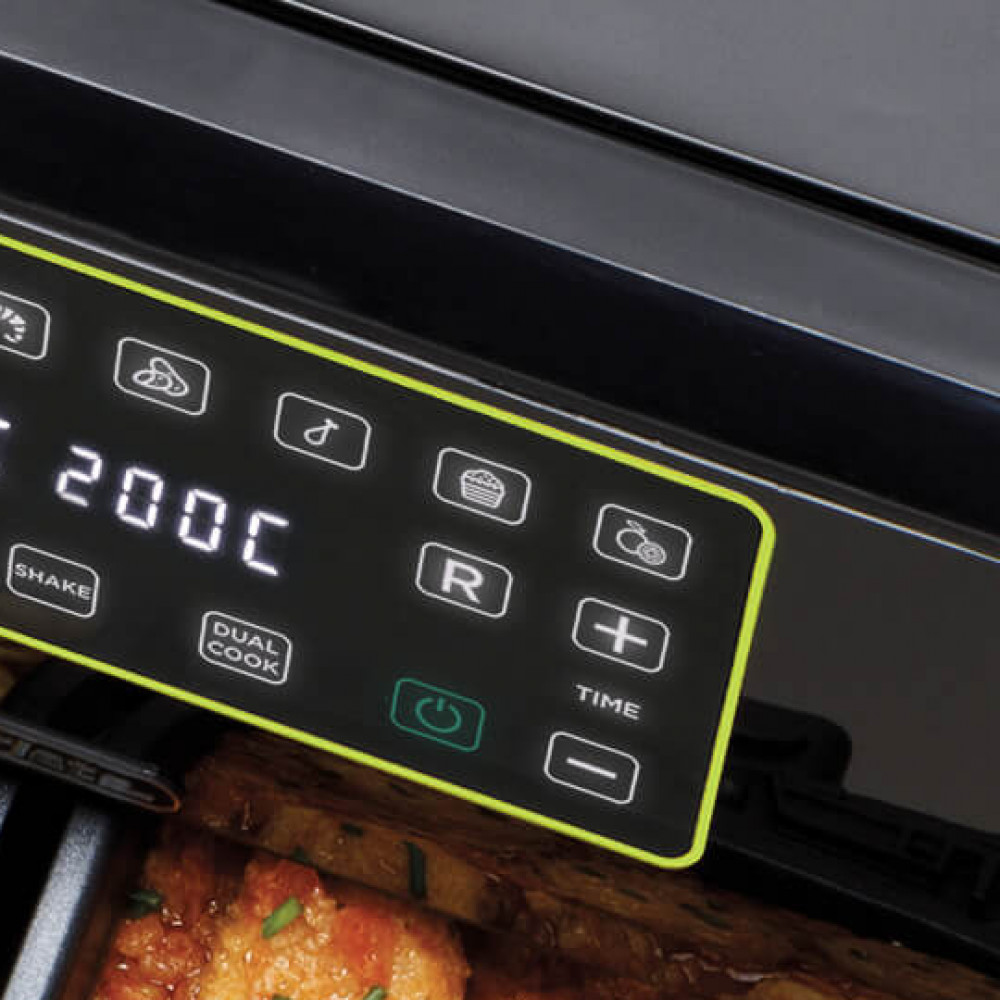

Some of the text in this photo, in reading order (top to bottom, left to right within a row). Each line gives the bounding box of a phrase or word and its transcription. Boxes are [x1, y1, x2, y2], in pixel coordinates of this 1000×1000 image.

[55, 444, 291, 577] 200C
[13, 562, 93, 601] SHAKE
[440, 557, 485, 605] R
[207, 639, 280, 677] COOK
[213, 621, 280, 656] DUAL
[575, 683, 643, 722] TIME
